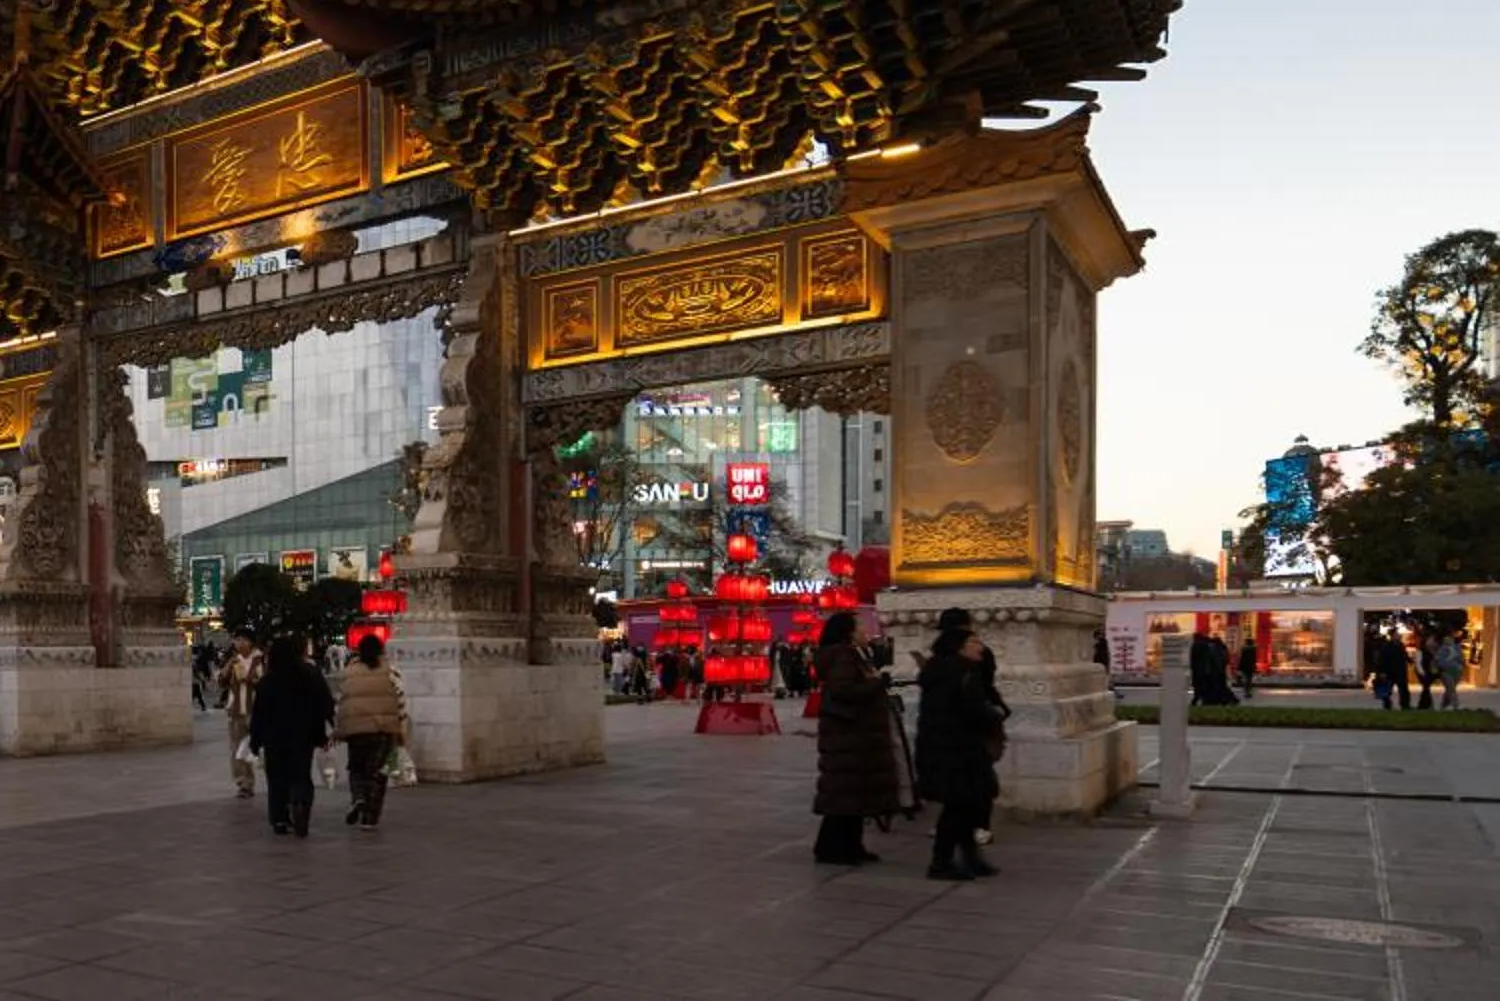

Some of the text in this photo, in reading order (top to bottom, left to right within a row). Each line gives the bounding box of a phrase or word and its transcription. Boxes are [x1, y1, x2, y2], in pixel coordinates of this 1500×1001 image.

[731, 468, 762, 483] UNI
[731, 484, 765, 501] QLO
[766, 579, 831, 595] HUAWE
